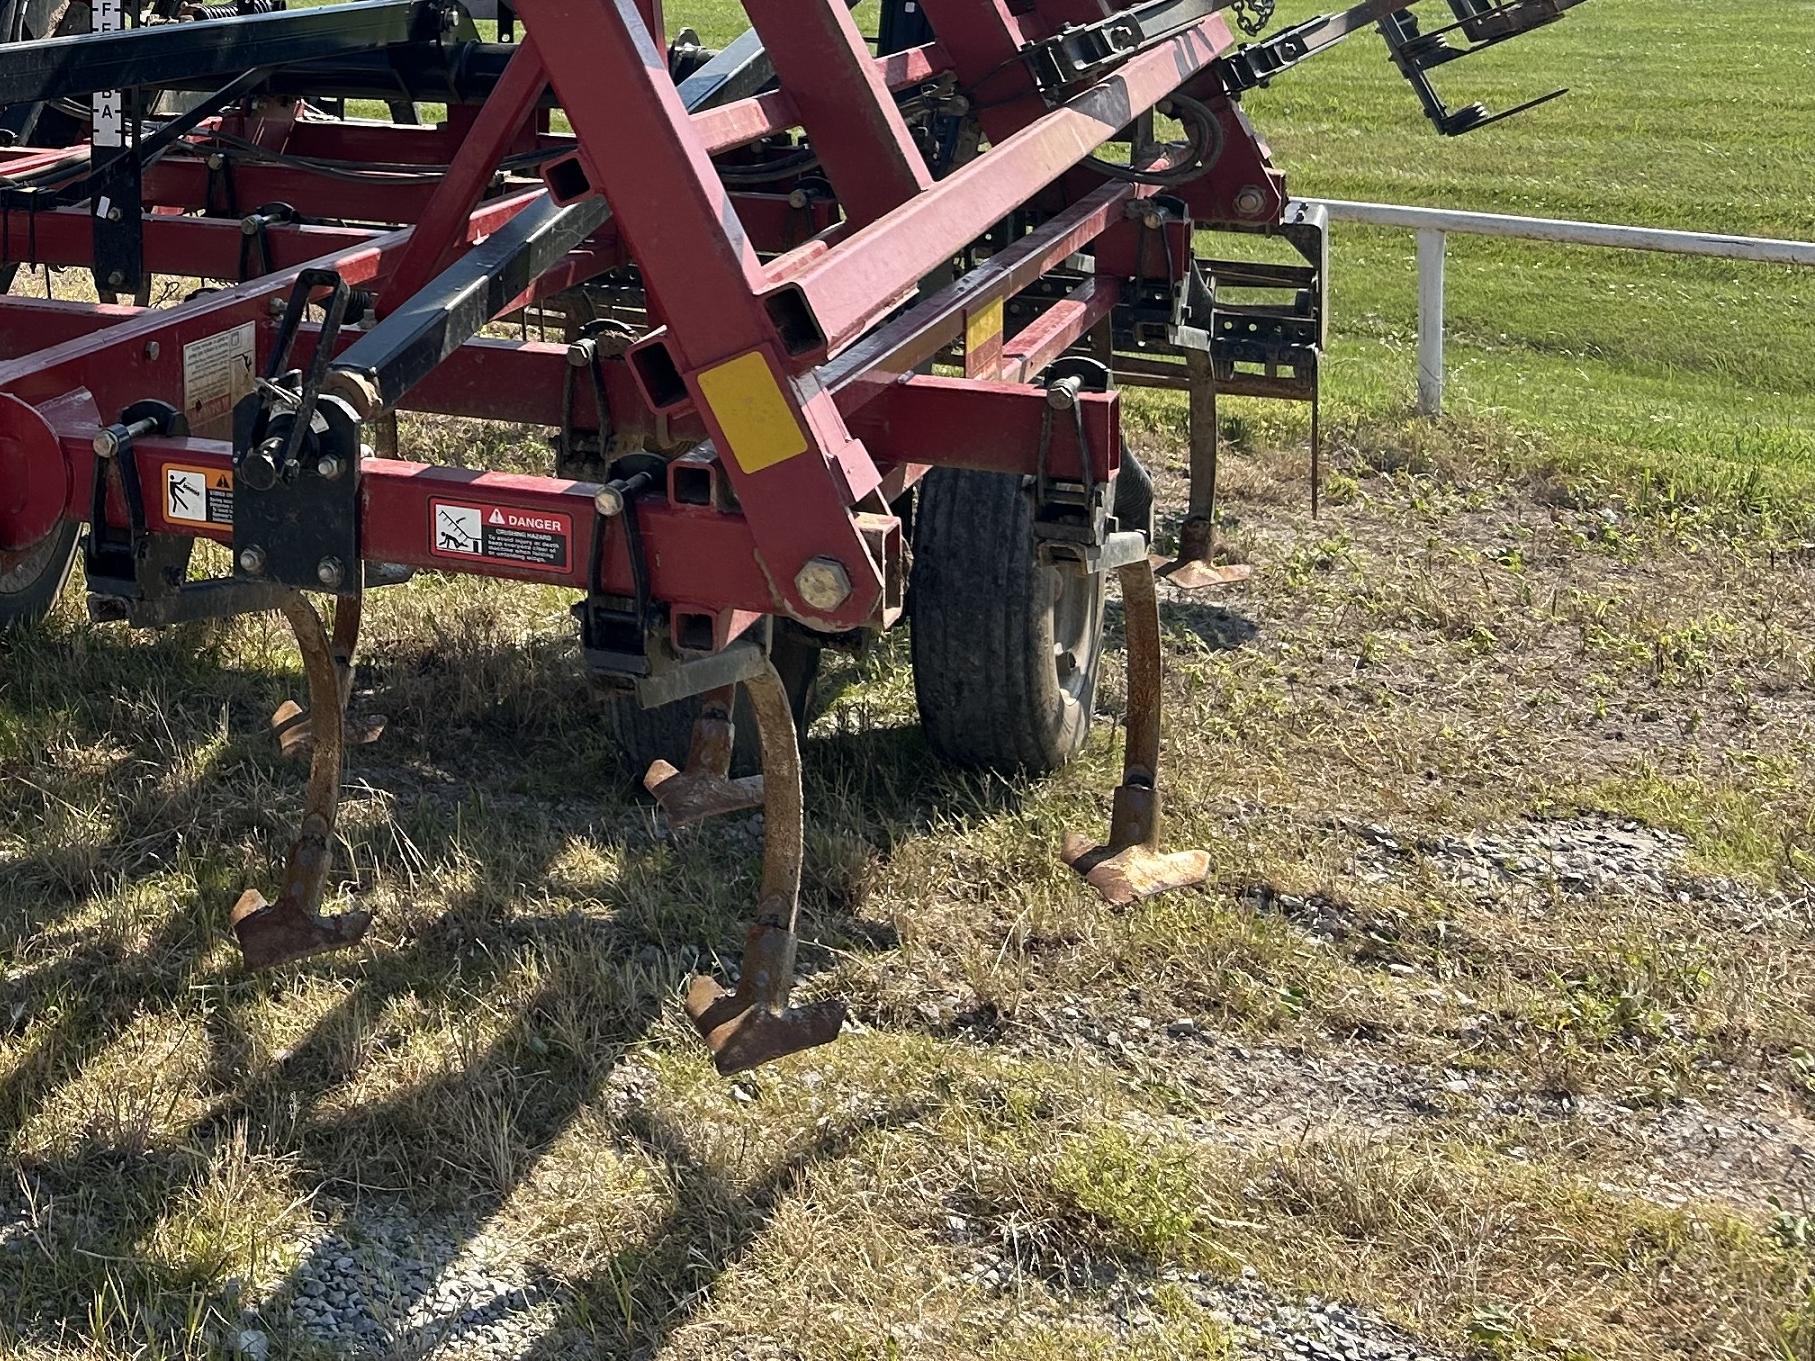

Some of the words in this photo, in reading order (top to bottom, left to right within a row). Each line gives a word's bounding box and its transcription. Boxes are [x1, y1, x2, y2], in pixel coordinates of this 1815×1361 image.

[102, 2, 112, 17] F
[101, 105, 113, 119] A
[508, 515, 561, 531] DANGER
